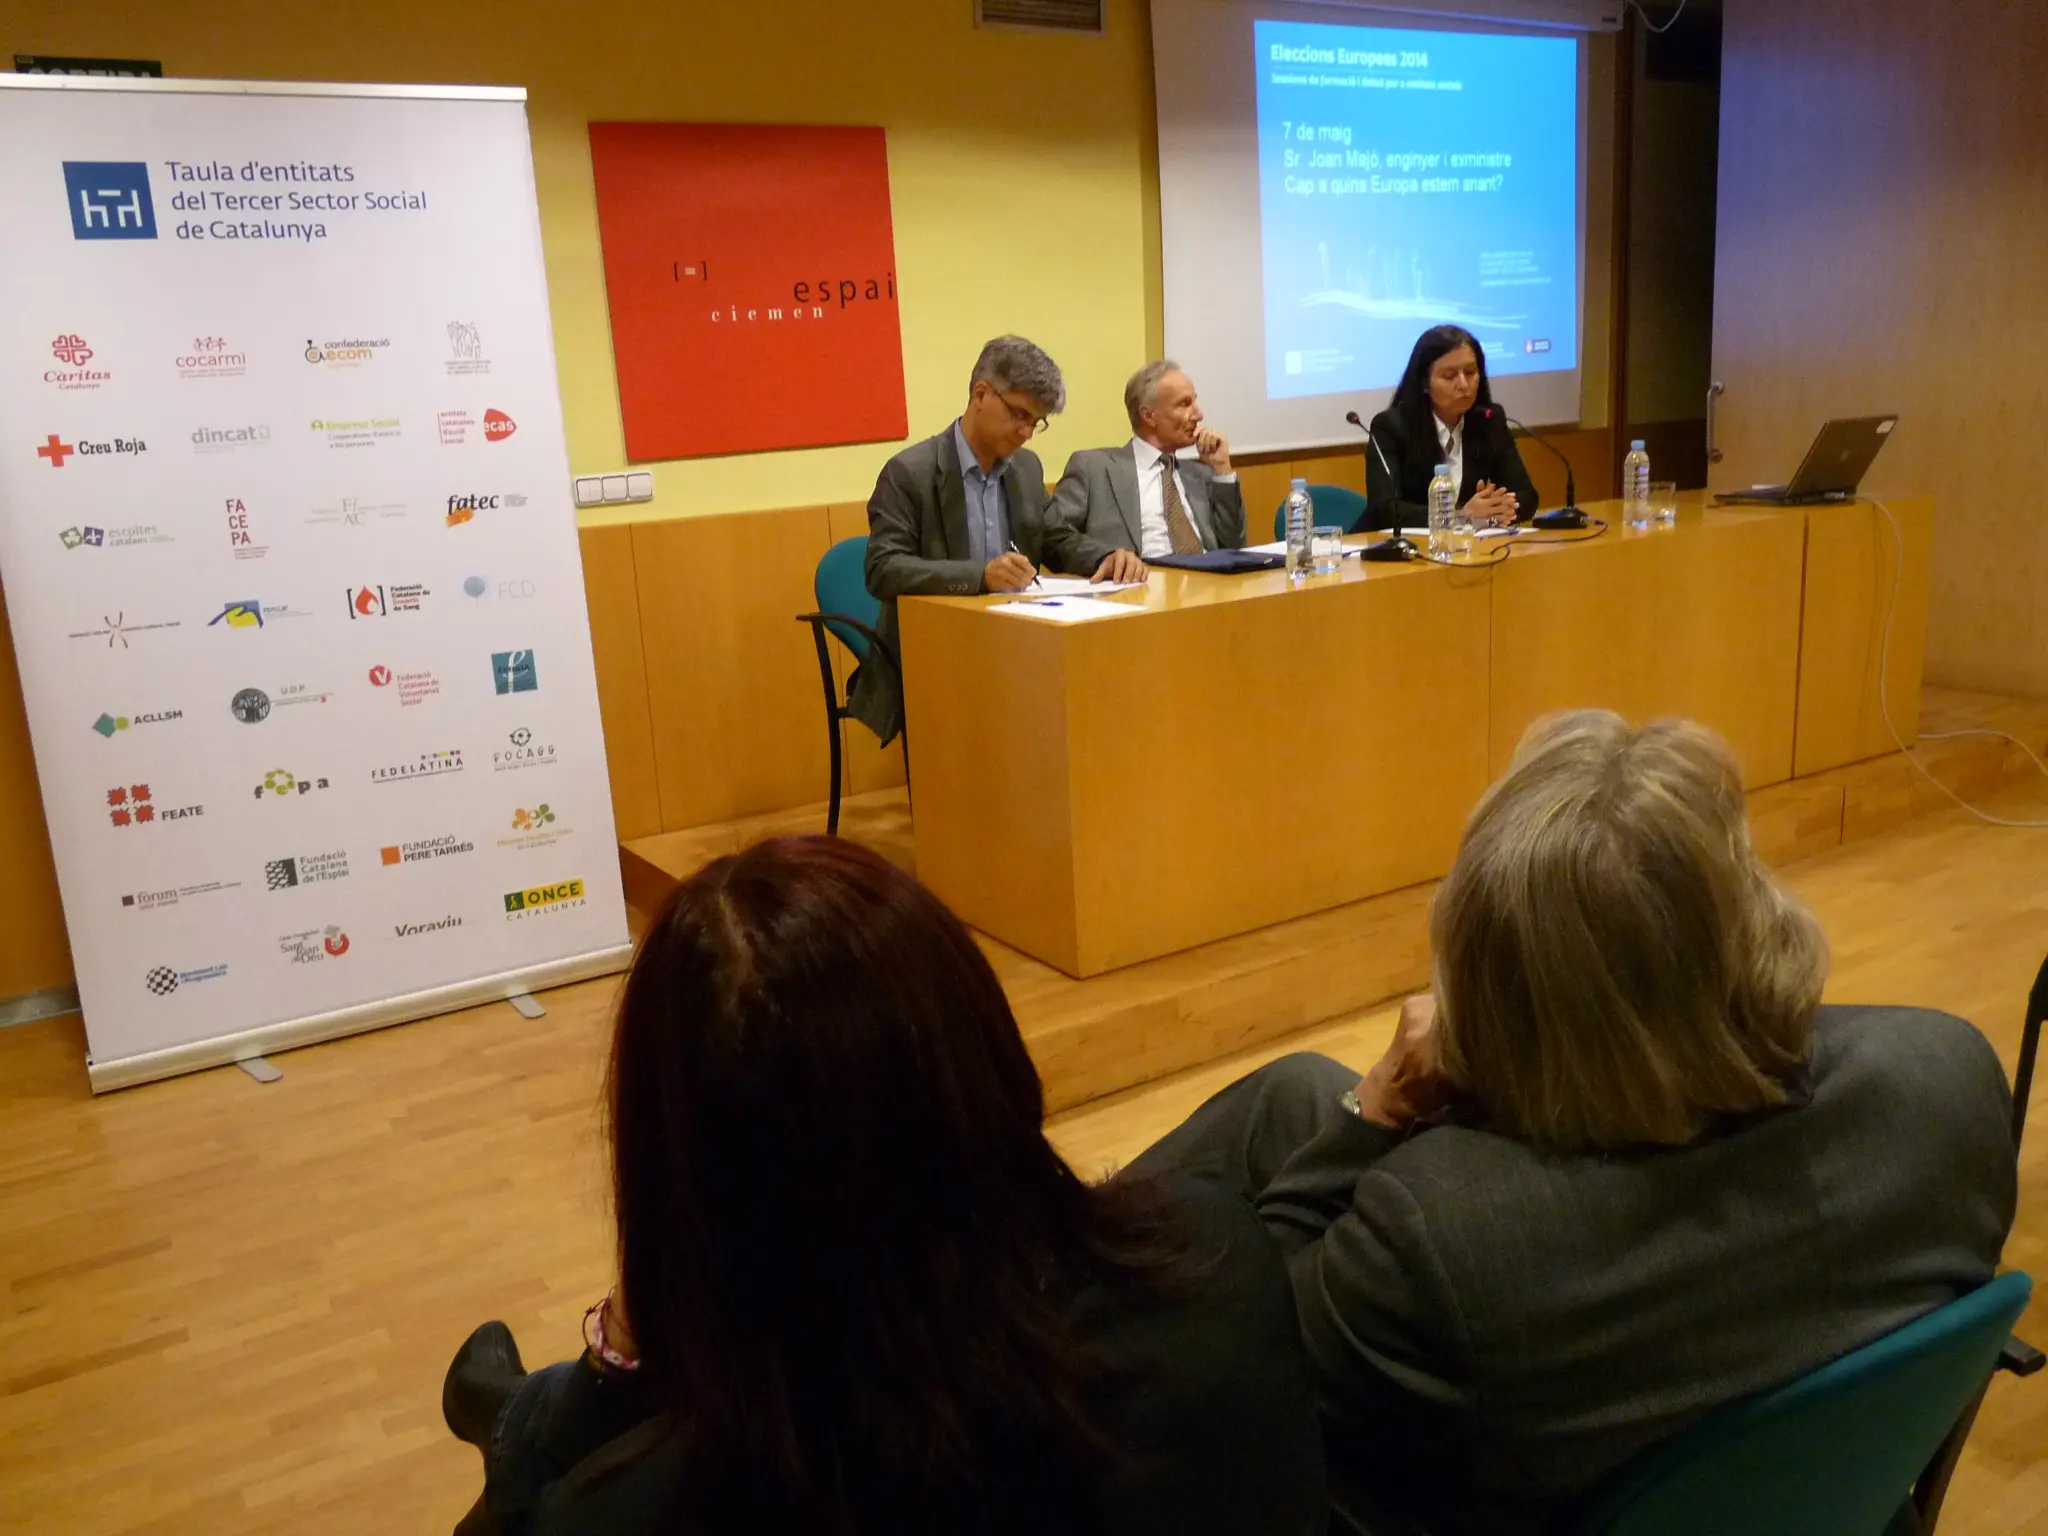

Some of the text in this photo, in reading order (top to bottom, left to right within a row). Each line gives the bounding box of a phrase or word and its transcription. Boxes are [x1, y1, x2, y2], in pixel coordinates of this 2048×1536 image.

[1270, 44, 1428, 68] Eleccions Europees 2014
[1282, 122, 1352, 145] 7 de maig
[1309, 149, 1342, 168] Joan
[1385, 152, 1440, 172] enginyer
[1450, 151, 1513, 168] exministre
[165, 161, 355, 182] Taula d'entitats
[1284, 174, 1314, 197] Cap
[1318, 178, 1328, 194] a
[1371, 174, 1419, 196] Europa
[1421, 175, 1459, 193] estem
[1462, 173, 1504, 192] anant?
[171, 189, 427, 211] del Tercer Sector Social
[176, 219, 328, 243] de Catalunya
[793, 272, 893, 309] espai
[711, 304, 824, 323] ciemen
[324, 337, 390, 349] confederació
[175, 351, 247, 368] cocarmi
[326, 348, 373, 361] ecom
[43, 370, 111, 383] Càritas
[191, 425, 258, 444] dincat
[484, 420, 514, 432] ecas
[78, 437, 147, 455] Creu Roja
[225, 498, 246, 514] FA
[447, 493, 500, 515] fatec
[229, 514, 249, 530] CE
[231, 530, 251, 546] PA
[498, 579, 535, 599] FCD
[133, 710, 183, 725] ACLLSM
[493, 744, 555, 765] FOCAGG
[371, 757, 464, 780] FEDELATINA
[161, 804, 204, 821] FEATE
[402, 834, 455, 852] FUNDACIÓ
[403, 841, 474, 863] PERE TARRÉS
[300, 848, 347, 865] Fundació
[301, 860, 348, 874] Catalana
[302, 874, 314, 883] de
[527, 881, 580, 905] ONCE
[506, 898, 587, 922] CATALUNYA
[394, 914, 463, 938] Voraviu
